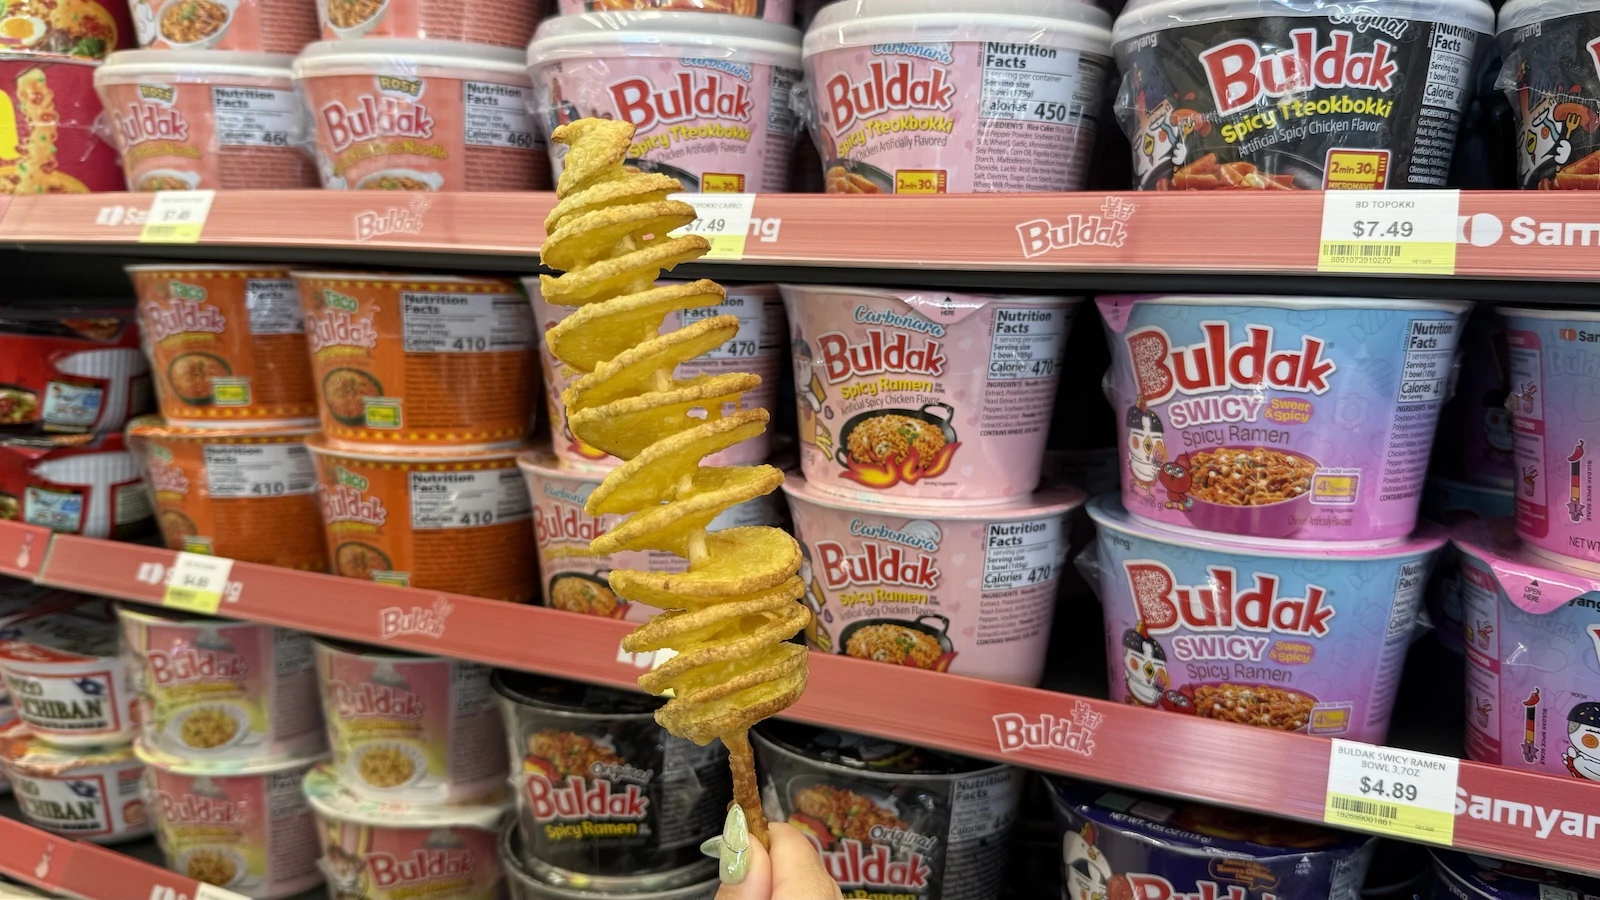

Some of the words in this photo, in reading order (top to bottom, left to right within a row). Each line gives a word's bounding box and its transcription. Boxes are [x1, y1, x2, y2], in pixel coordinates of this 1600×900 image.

[1437, 23, 1476, 43] Nutrition
[987, 42, 1057, 59] Nutrition
[1434, 35, 1462, 52] Facts
[986, 55, 1027, 69] Facts
[1430, 61, 1451, 74] Serving
[1020, 72, 1031, 80] per
[1032, 74, 1062, 83] container
[1198, 28, 1400, 116] Buldak
[467, 83, 522, 98] Nutrition
[1016, 79, 1030, 88] size
[1426, 84, 1455, 100] Calories
[467, 94, 499, 106] Facts
[606, 70, 753, 134] Buldak
[825, 58, 956, 137] Buldak
[982, 99, 1027, 112] Calories
[1034, 103, 1067, 121] 450
[323, 94, 437, 154] Buldak
[1219, 109, 1278, 145] Spicy
[1277, 95, 1394, 121] Tteokbokki
[508, 133, 532, 148] 460
[629, 131, 670, 158] Spicy
[669, 123, 752, 142] Tteokbokki
[838, 131, 867, 158] Spicy
[865, 117, 955, 137] Tteokbokki
[914, 135, 948, 148] Flavored
[1237, 130, 1279, 158] Artificial
[1279, 124, 1307, 144] Spicy
[1308, 120, 1349, 137] Chicken
[1351, 117, 1382, 134] Flavor
[1331, 160, 1355, 175] 2min
[1356, 161, 1377, 176] 30s
[1327, 181, 1375, 190] MICROWAVE
[1372, 201, 1415, 209] TOPOKKI
[356, 208, 424, 243] Buldak
[1352, 220, 1413, 239] $7.49
[1510, 215, 1600, 246] Sam
[1015, 214, 1127, 258] Buldak
[323, 288, 359, 313] Taco
[404, 294, 468, 306] Nutrition
[404, 304, 441, 315] Facts
[684, 307, 719, 318] Facts
[939, 309, 955, 317] HERE
[997, 310, 1052, 322] Nutrition
[146, 298, 227, 342] Buldak
[854, 304, 946, 338] Carbonara
[995, 322, 1029, 334] Facts
[1411, 322, 1453, 335] Nutrition
[305, 309, 378, 353] Buldak
[453, 336, 486, 351] 410
[728, 342, 757, 357] 470
[993, 344, 1018, 352] Serving
[1409, 336, 1437, 349] Facts
[816, 328, 947, 384] Buldak
[1125, 319, 1336, 405] Buldak
[990, 362, 1027, 373] Calories
[1031, 360, 1054, 376] 470
[1405, 361, 1427, 370] Serving
[1408, 370, 1423, 378] bowl
[840, 382, 879, 401] Spicy
[878, 377, 933, 394] Ramen
[1401, 382, 1432, 394] Calories
[865, 398, 884, 410] Spicy
[885, 395, 915, 406] Chicken
[1270, 398, 1310, 412] Sweet
[1169, 394, 1267, 430] SWICY
[1264, 409, 1273, 419] &
[1274, 410, 1310, 424] Spicy
[1182, 429, 1224, 447] Spicy
[1229, 426, 1290, 444] Ramen
[336, 466, 370, 491] Taco
[412, 474, 476, 484] Nutrition
[412, 484, 448, 493] Facts
[460, 511, 493, 526] 410
[849, 518, 938, 552] Carbonara
[990, 522, 1047, 536] Nutrition
[988, 536, 1023, 547] Facts
[1568, 536, 1586, 549] NET
[815, 538, 941, 590] Buldak
[986, 556, 1013, 564] Serving
[992, 563, 1008, 571] bowl
[984, 572, 1023, 584] Calories
[1027, 565, 1051, 583] 470
[838, 591, 875, 609] Spicy
[874, 587, 929, 605] Ramen
[1122, 558, 1336, 638] Buldak
[1523, 585, 1542, 596] OPEN
[1523, 592, 1540, 603] HERE
[862, 606, 881, 618] Spicy
[880, 604, 910, 616] Chicken
[379, 606, 446, 639] Buldak
[1171, 634, 1270, 662] SWICY
[1275, 640, 1313, 652] Sweet
[1277, 651, 1311, 664] Spicy
[149, 649, 249, 687] Buldak
[1185, 662, 1230, 681] Spicy
[1233, 664, 1293, 683] Ramen
[329, 678, 425, 719] Buldak
[992, 712, 1097, 757] Buldak
[1337, 745, 1376, 761] BULDAK
[1377, 752, 1409, 766] SWICY
[1410, 757, 1447, 772] RAMEN
[1361, 759, 1390, 773] BOWL
[590, 760, 655, 784] Original
[957, 773, 1011, 791] Nutrition
[1359, 775, 1418, 802] $4.89
[525, 771, 651, 822] Buldak
[956, 789, 989, 801] Facts
[159, 789, 243, 825] Buldak
[1454, 785, 1600, 840] Samyan
[544, 823, 584, 840] Spicy
[583, 821, 638, 836] Ramen
[869, 823, 939, 850] Original
[366, 848, 476, 889] Buldak
[822, 837, 932, 889] uldak
